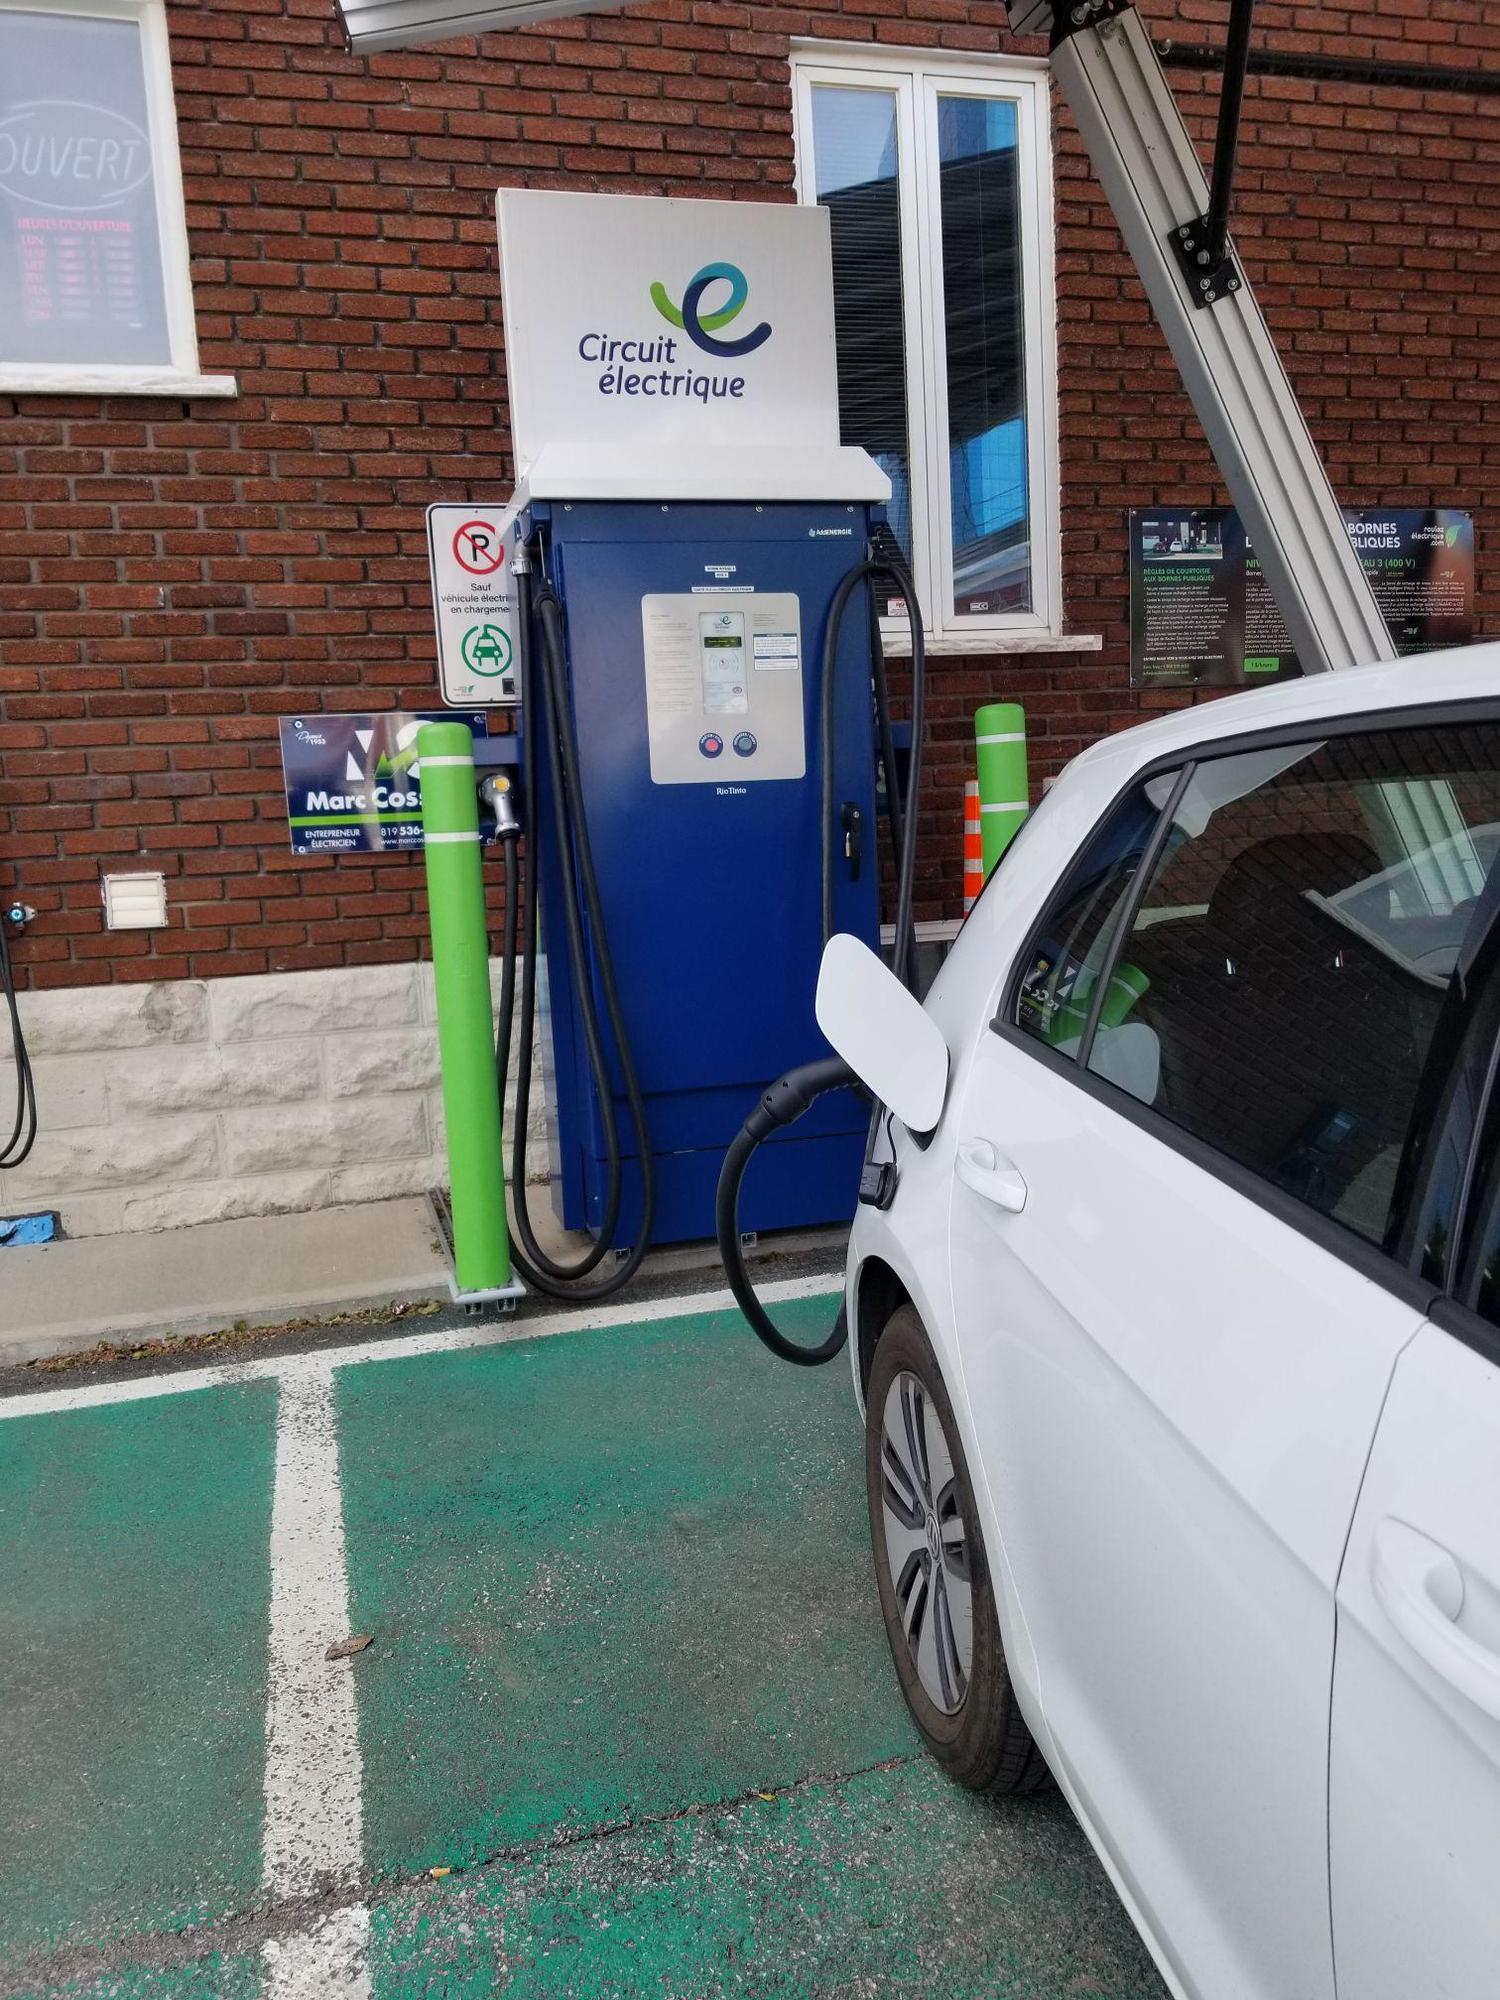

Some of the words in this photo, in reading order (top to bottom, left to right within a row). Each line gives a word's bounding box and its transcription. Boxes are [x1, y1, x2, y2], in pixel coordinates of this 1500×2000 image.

[0, 132, 142, 181] OUVERT
[578, 333, 677, 363] Circuit
[599, 365, 745, 404] électrique
[1348, 523, 1397, 535] BORNES
[1351, 537, 1400, 548] BLIQUES
[1377, 559, 1383, 567] 3
[1385, 558, 1404, 568] (400
[1406, 559, 1416, 568] V)
[471, 583, 491, 591] Sauf
[441, 593, 479, 602] véhicule
[481, 593, 508, 602] électri
[464, 604, 509, 615] chargeme
[307, 791, 367, 811] Marc
[371, 786, 423, 808] Cos
[305, 828, 361, 838] ENTREPRENEUR
[380, 827, 398, 837] 819
[311, 837, 357, 848] ÉLECTRICIEN
